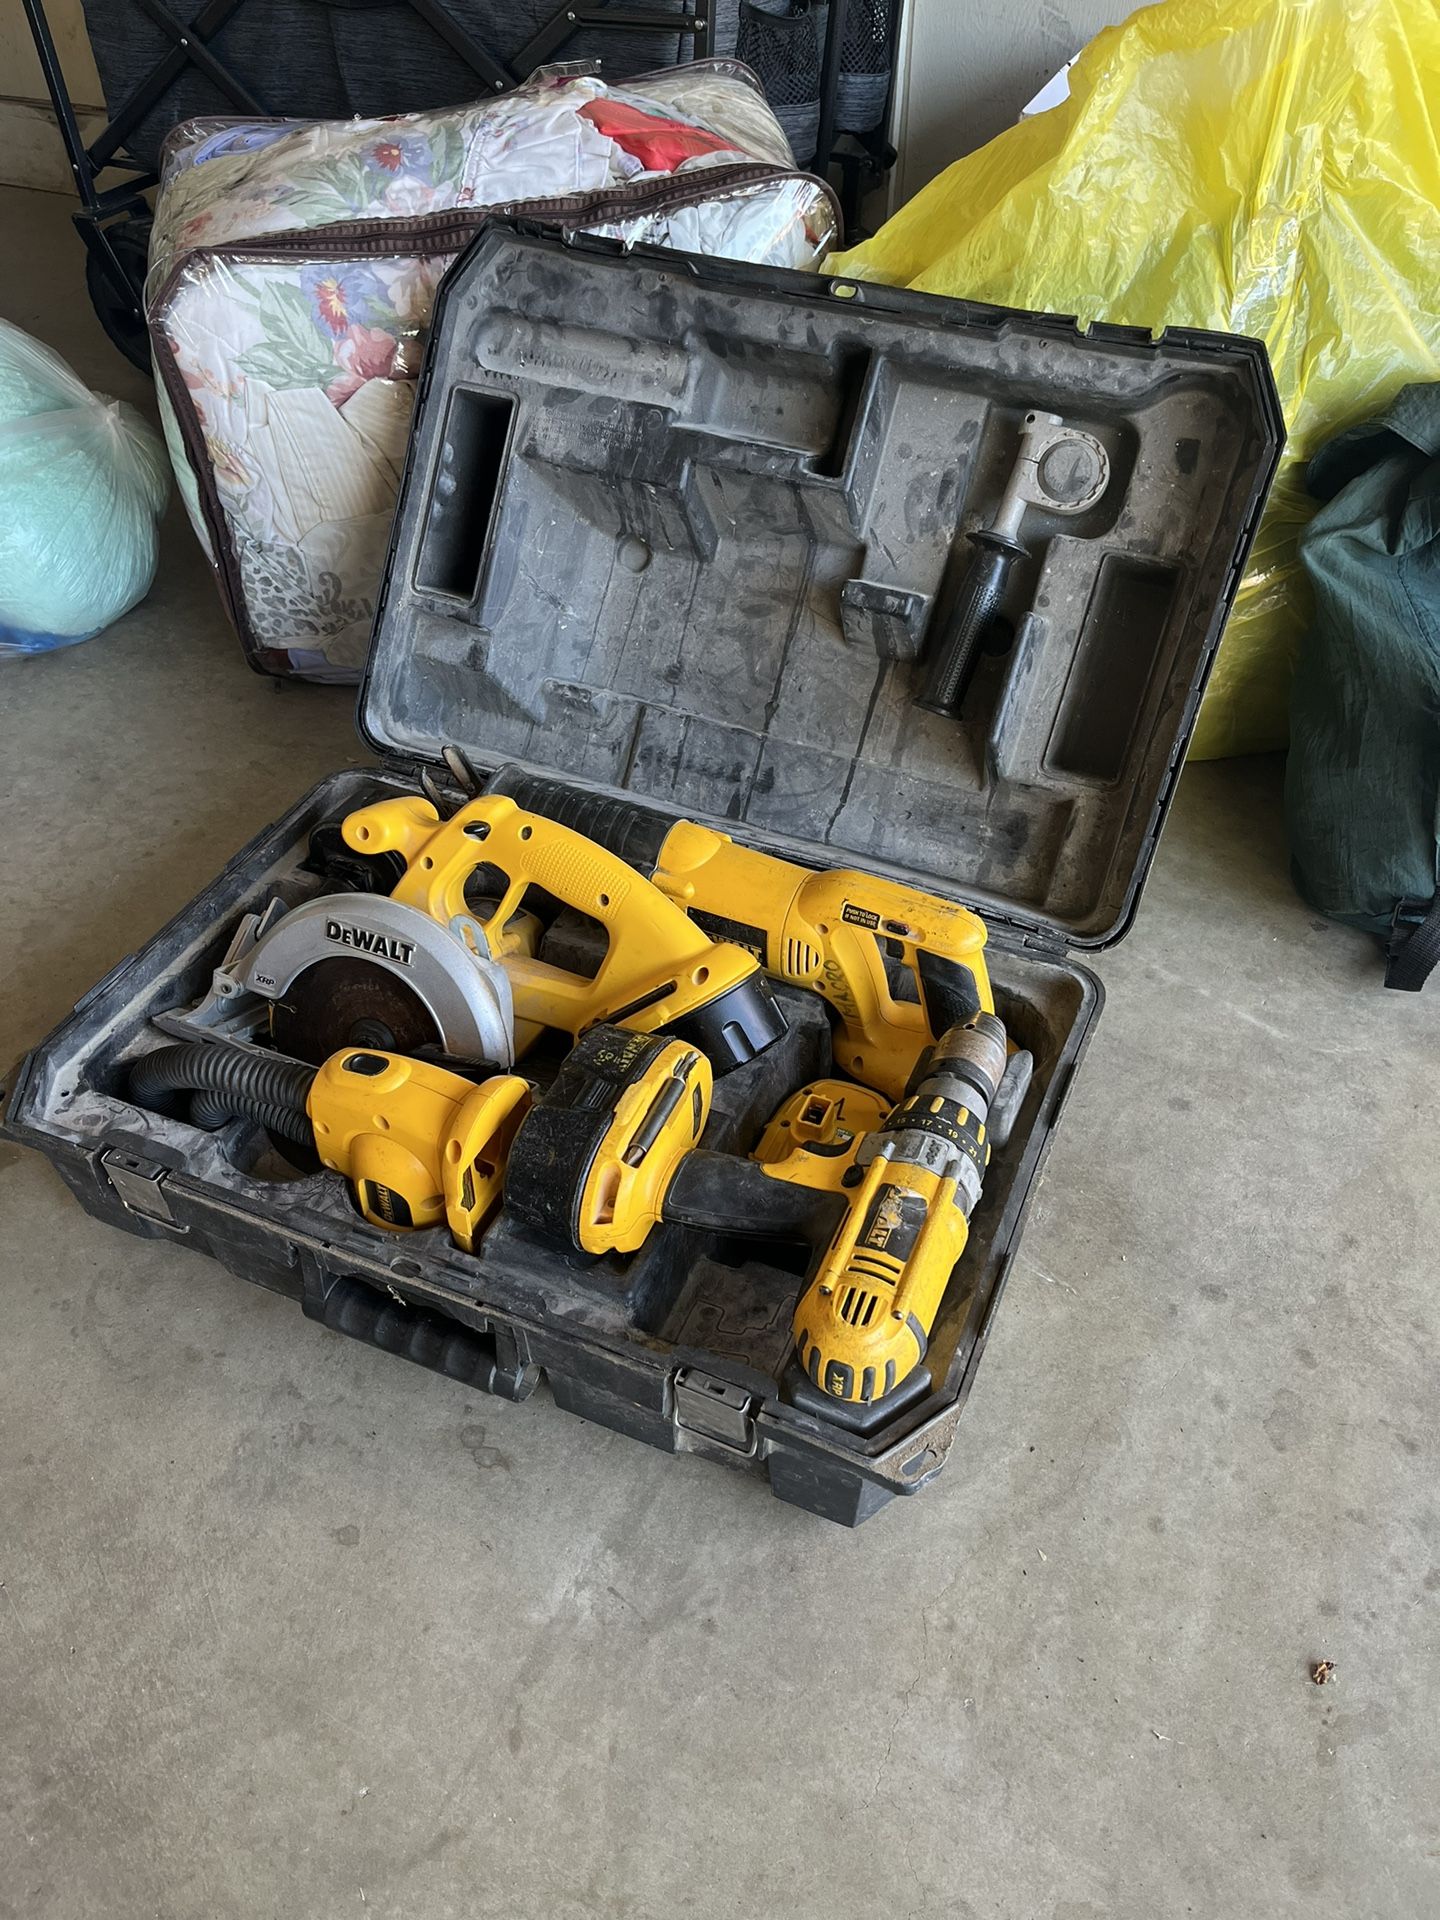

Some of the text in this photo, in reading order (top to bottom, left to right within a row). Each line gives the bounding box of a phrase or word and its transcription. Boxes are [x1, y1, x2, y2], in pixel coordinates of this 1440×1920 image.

[845, 907, 859, 916] PUSH
[865, 911, 879, 921] LOCK
[850, 914, 860, 922] NOT
[256, 974, 275, 986] XRP
[921, 1118, 933, 1126] 17
[947, 1128, 959, 1139] 19
[968, 1145, 978, 1158] 21
[832, 1371, 844, 1396] XRP
